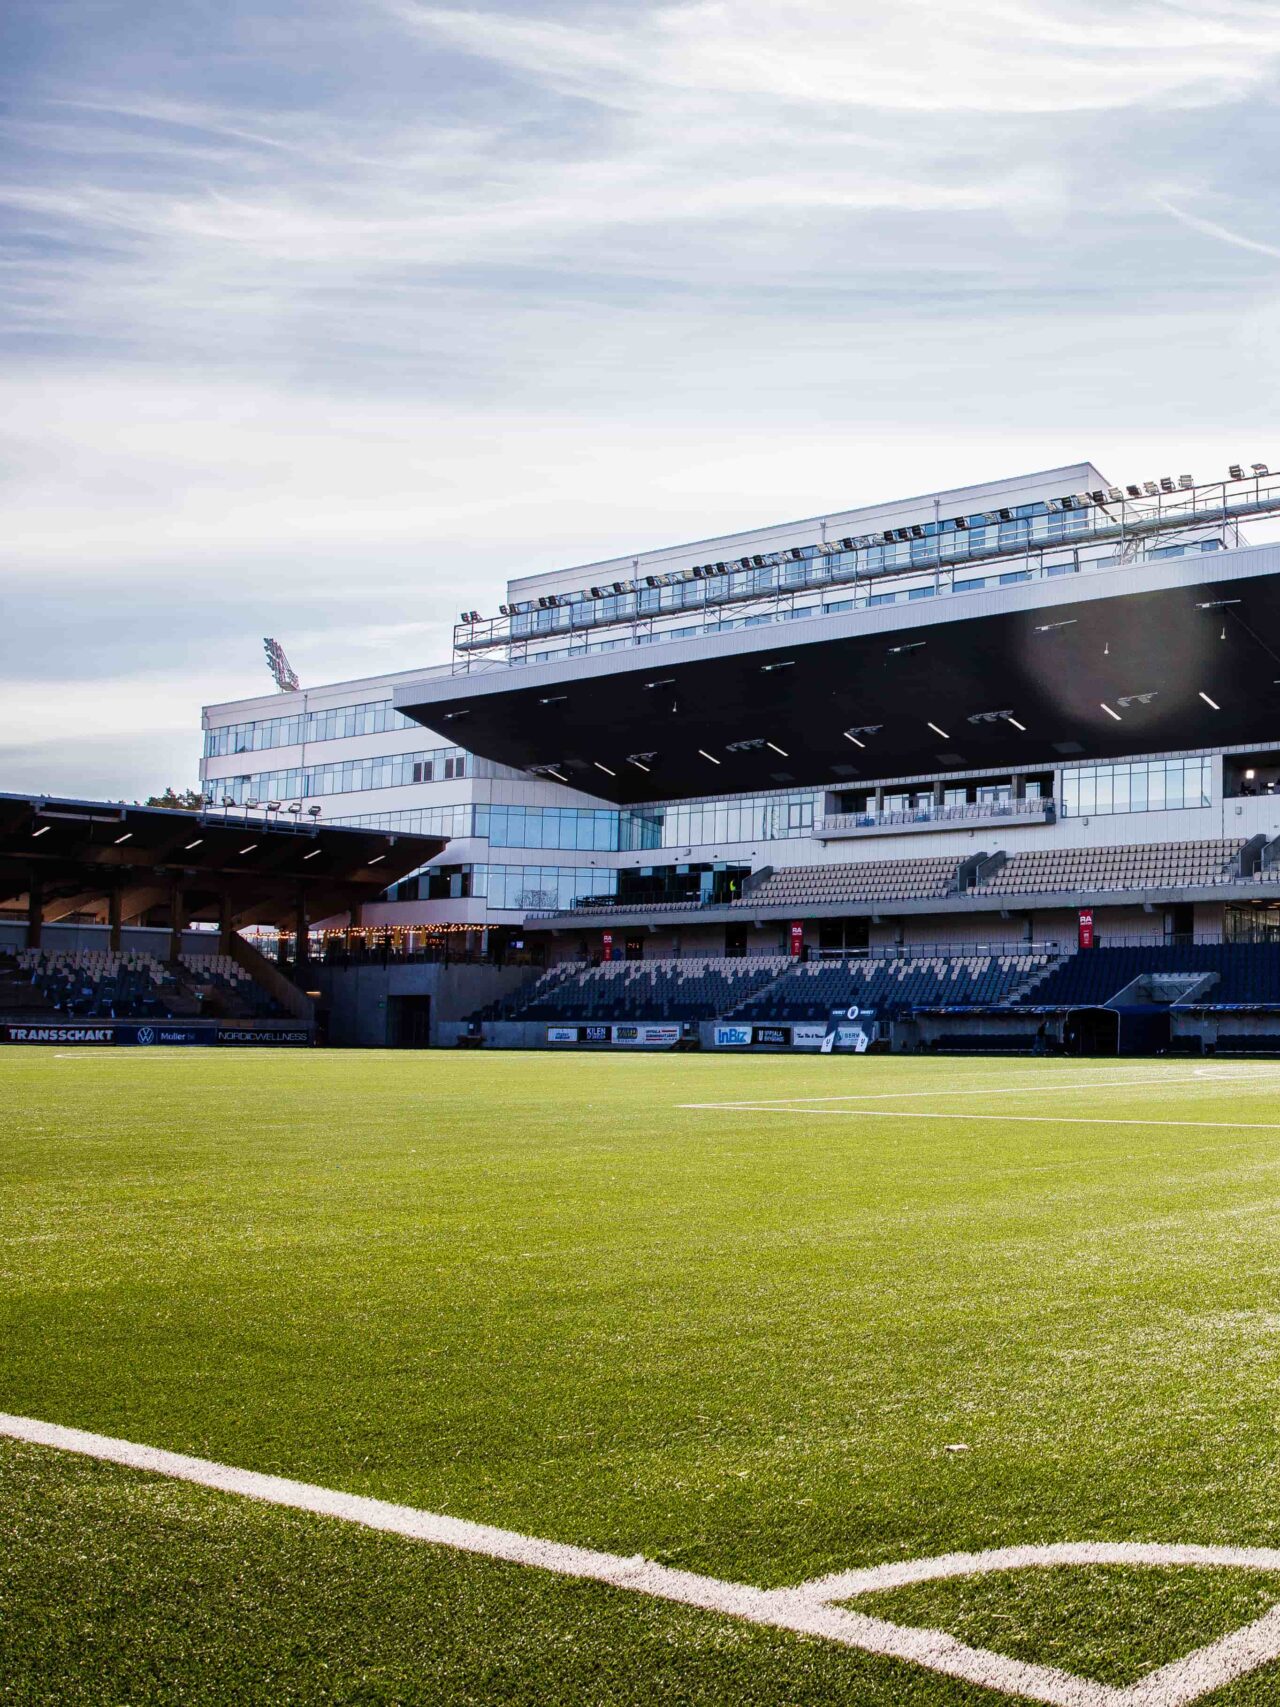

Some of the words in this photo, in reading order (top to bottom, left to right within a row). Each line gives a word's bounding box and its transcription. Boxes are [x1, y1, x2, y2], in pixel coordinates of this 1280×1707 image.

[9, 1028, 114, 1041] TRANSSCHAKT
[586, 1027, 606, 1035] KILEN
[718, 1029, 747, 1043] InBiz
